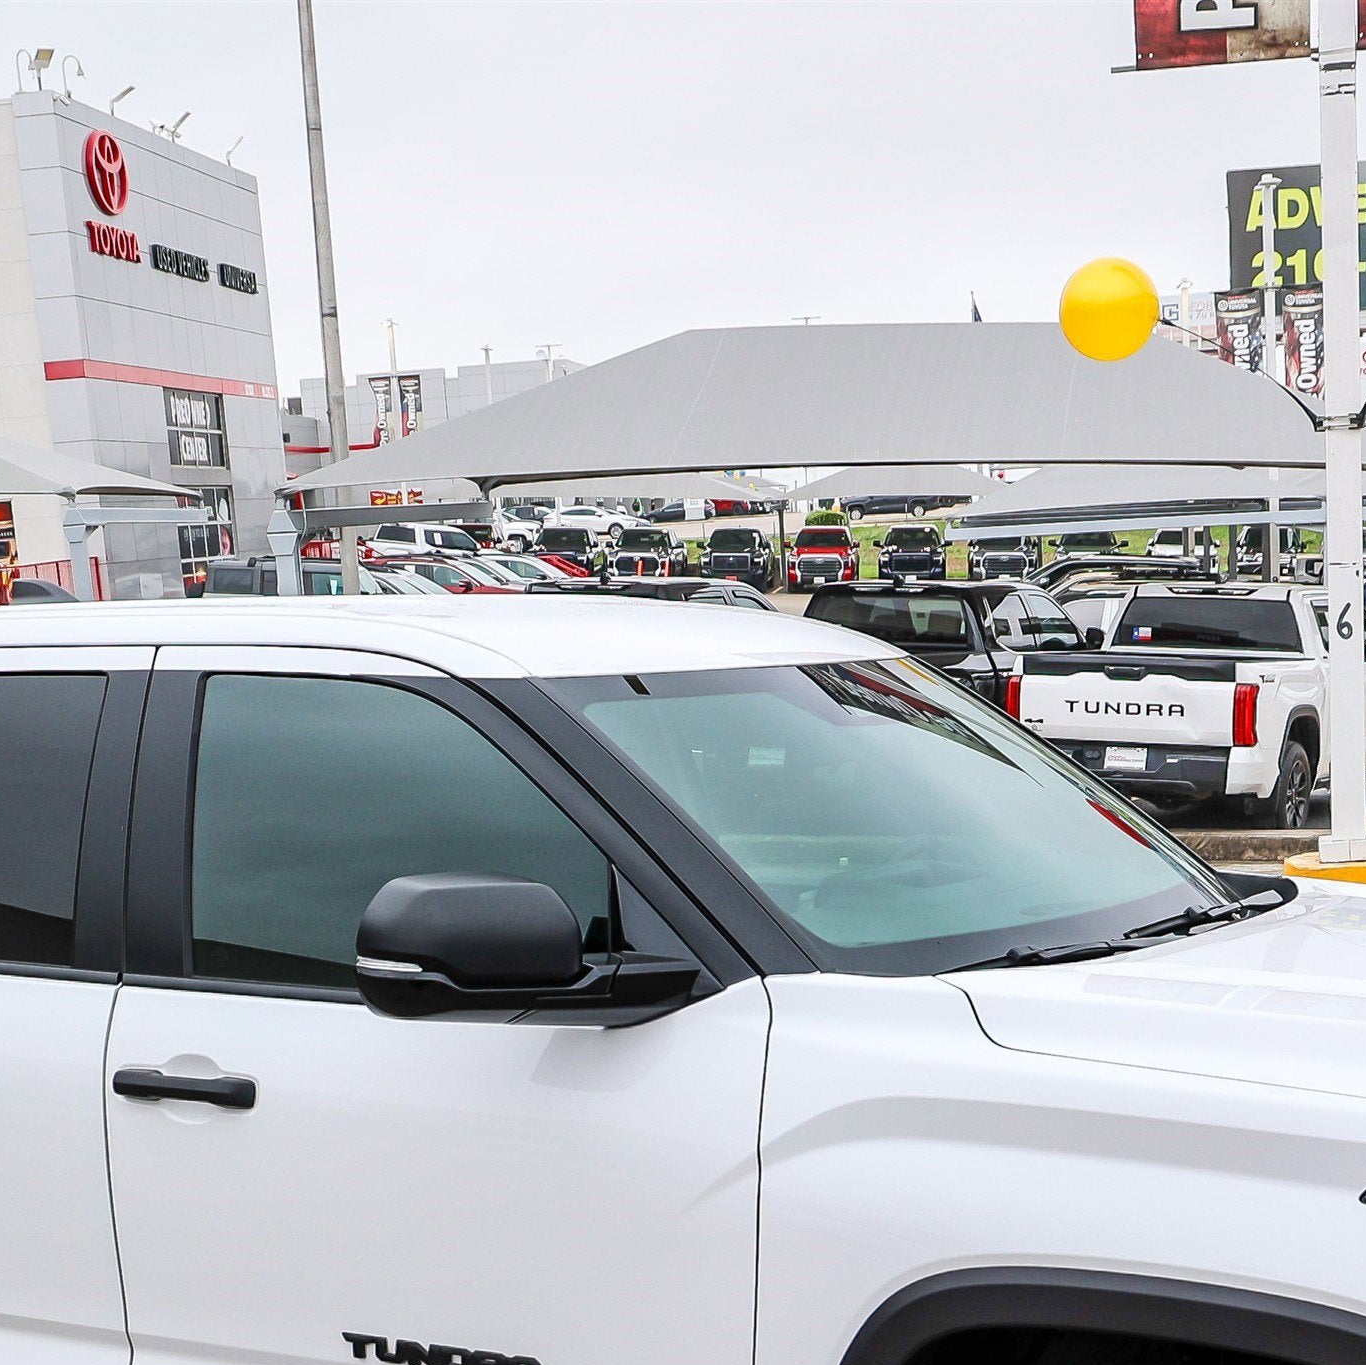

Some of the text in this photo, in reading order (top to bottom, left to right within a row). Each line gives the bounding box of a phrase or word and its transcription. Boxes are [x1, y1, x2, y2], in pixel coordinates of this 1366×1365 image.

[86, 220, 142, 263] TOYOTA
[1336, 602, 1353, 640] 6
[1064, 699, 1185, 717] TUNDRA
